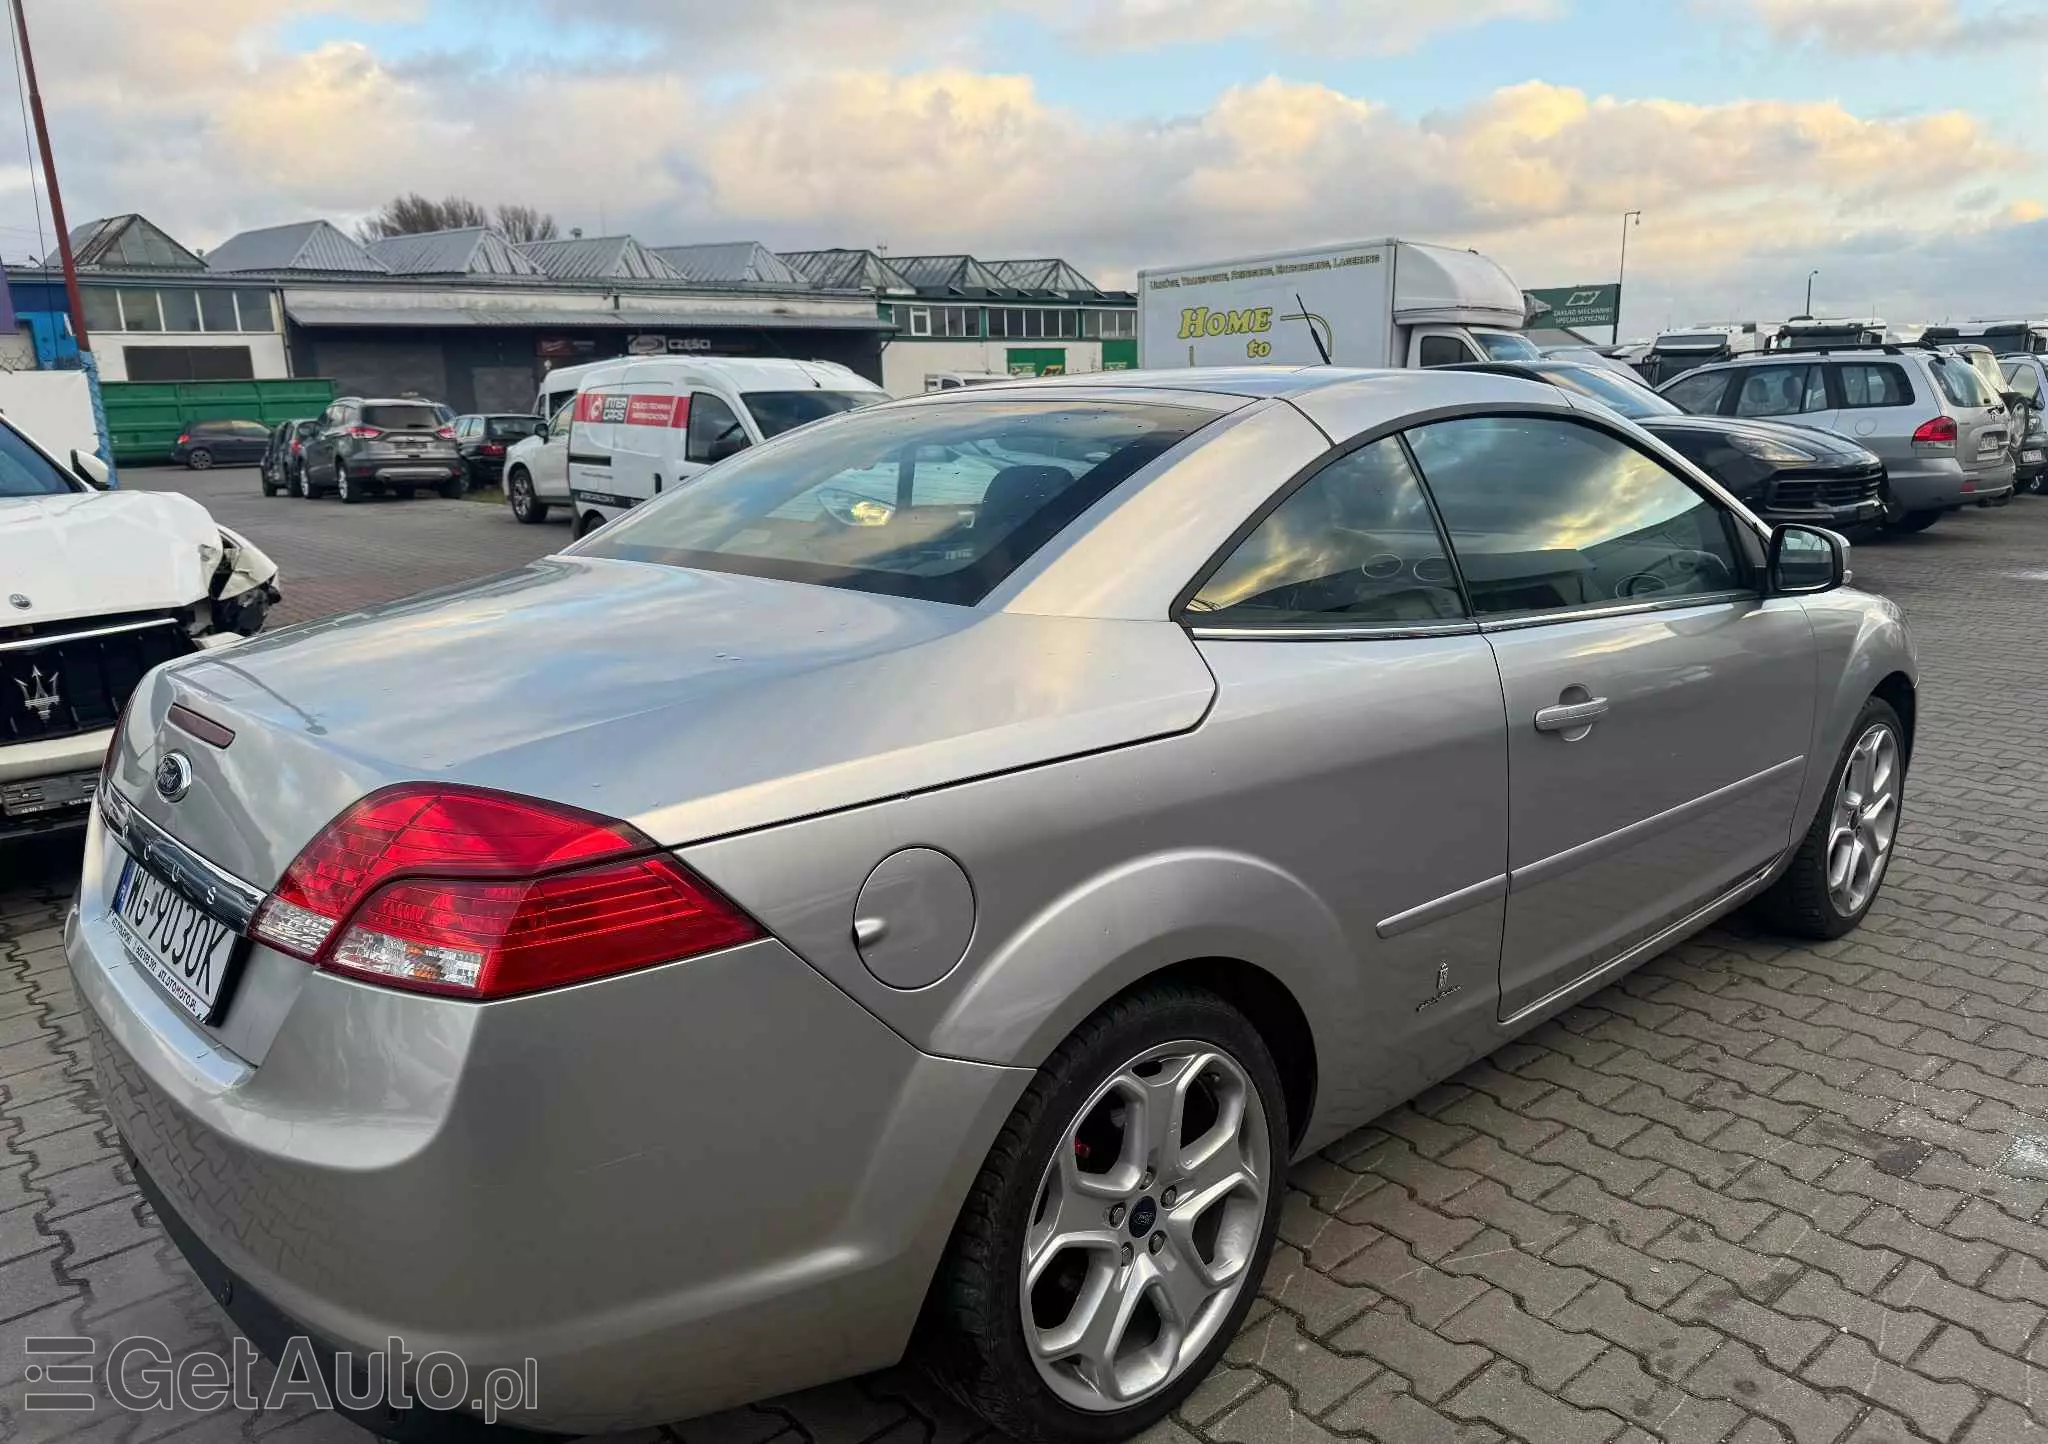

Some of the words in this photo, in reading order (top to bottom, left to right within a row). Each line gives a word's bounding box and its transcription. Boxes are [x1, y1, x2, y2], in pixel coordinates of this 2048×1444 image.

[1177, 307, 1273, 339] HOME
[1246, 339, 1272, 358] to
[605, 397, 628, 409] INTER
